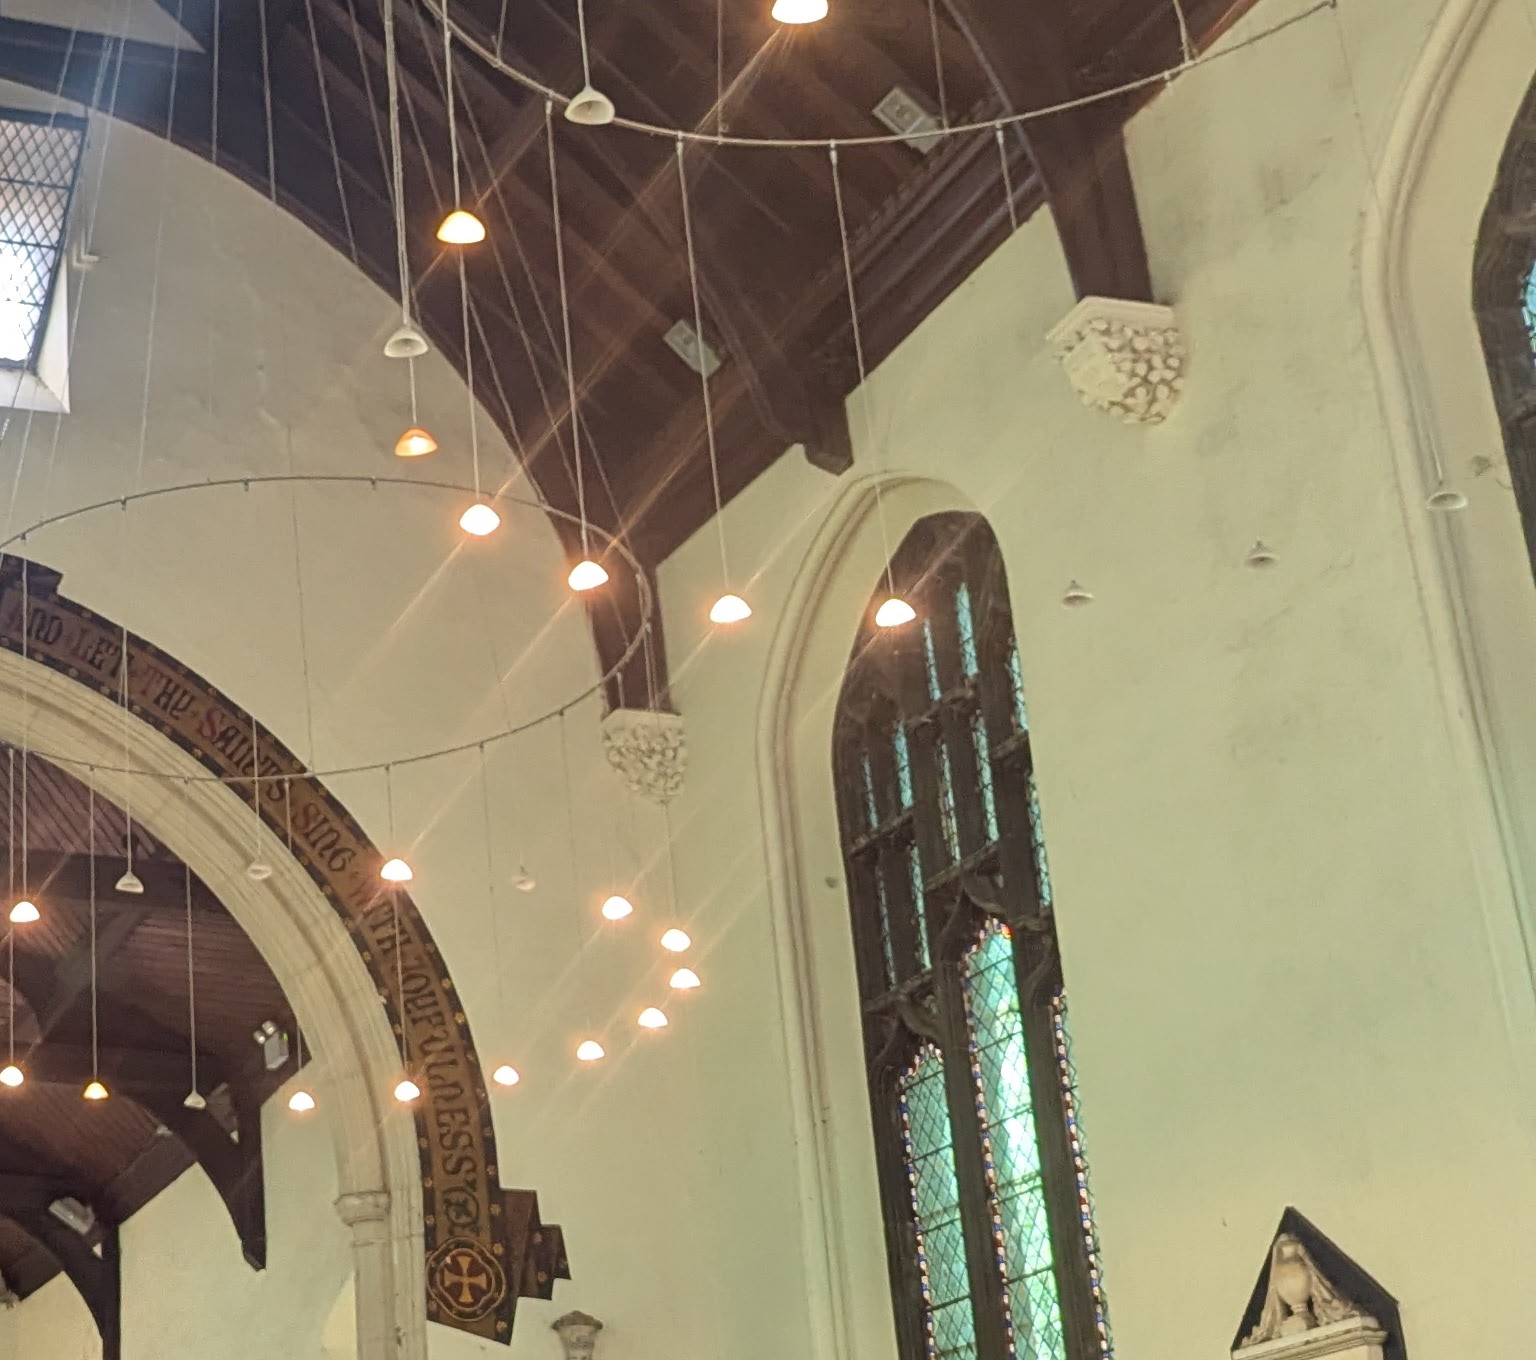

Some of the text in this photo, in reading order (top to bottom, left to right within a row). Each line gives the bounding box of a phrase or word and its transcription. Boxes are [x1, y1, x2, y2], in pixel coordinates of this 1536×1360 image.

[198, 709, 293, 802] SAINTS
[293, 801, 357, 873] SING
[348, 880, 414, 958] WITH
